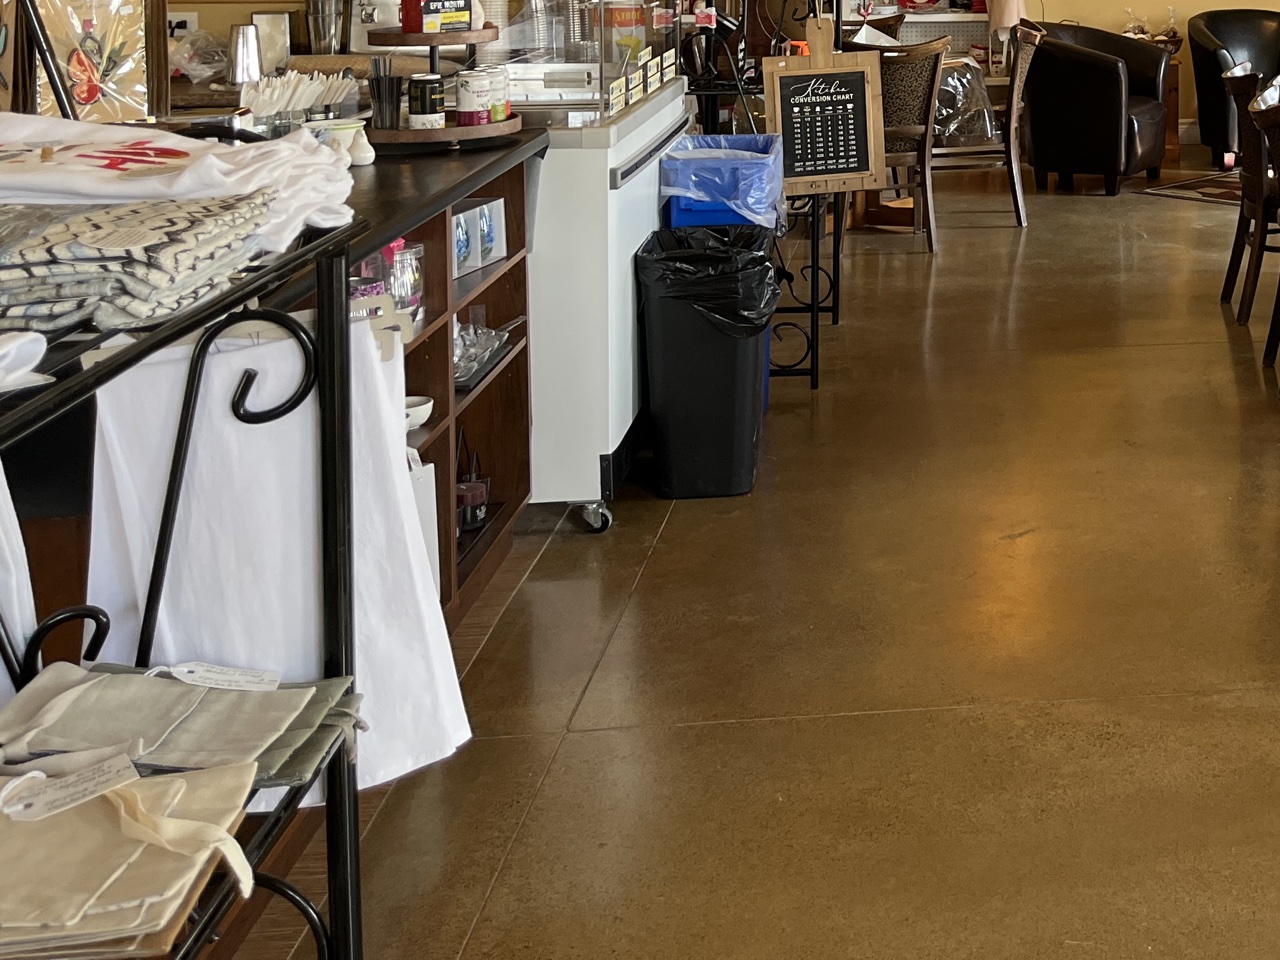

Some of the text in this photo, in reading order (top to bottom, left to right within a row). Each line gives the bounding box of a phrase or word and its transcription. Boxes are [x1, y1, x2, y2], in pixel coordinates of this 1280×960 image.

[444, 0, 464, 8] NORTH
[790, 78, 850, 96] Kitchen
[790, 95, 831, 103] CONVERSION
